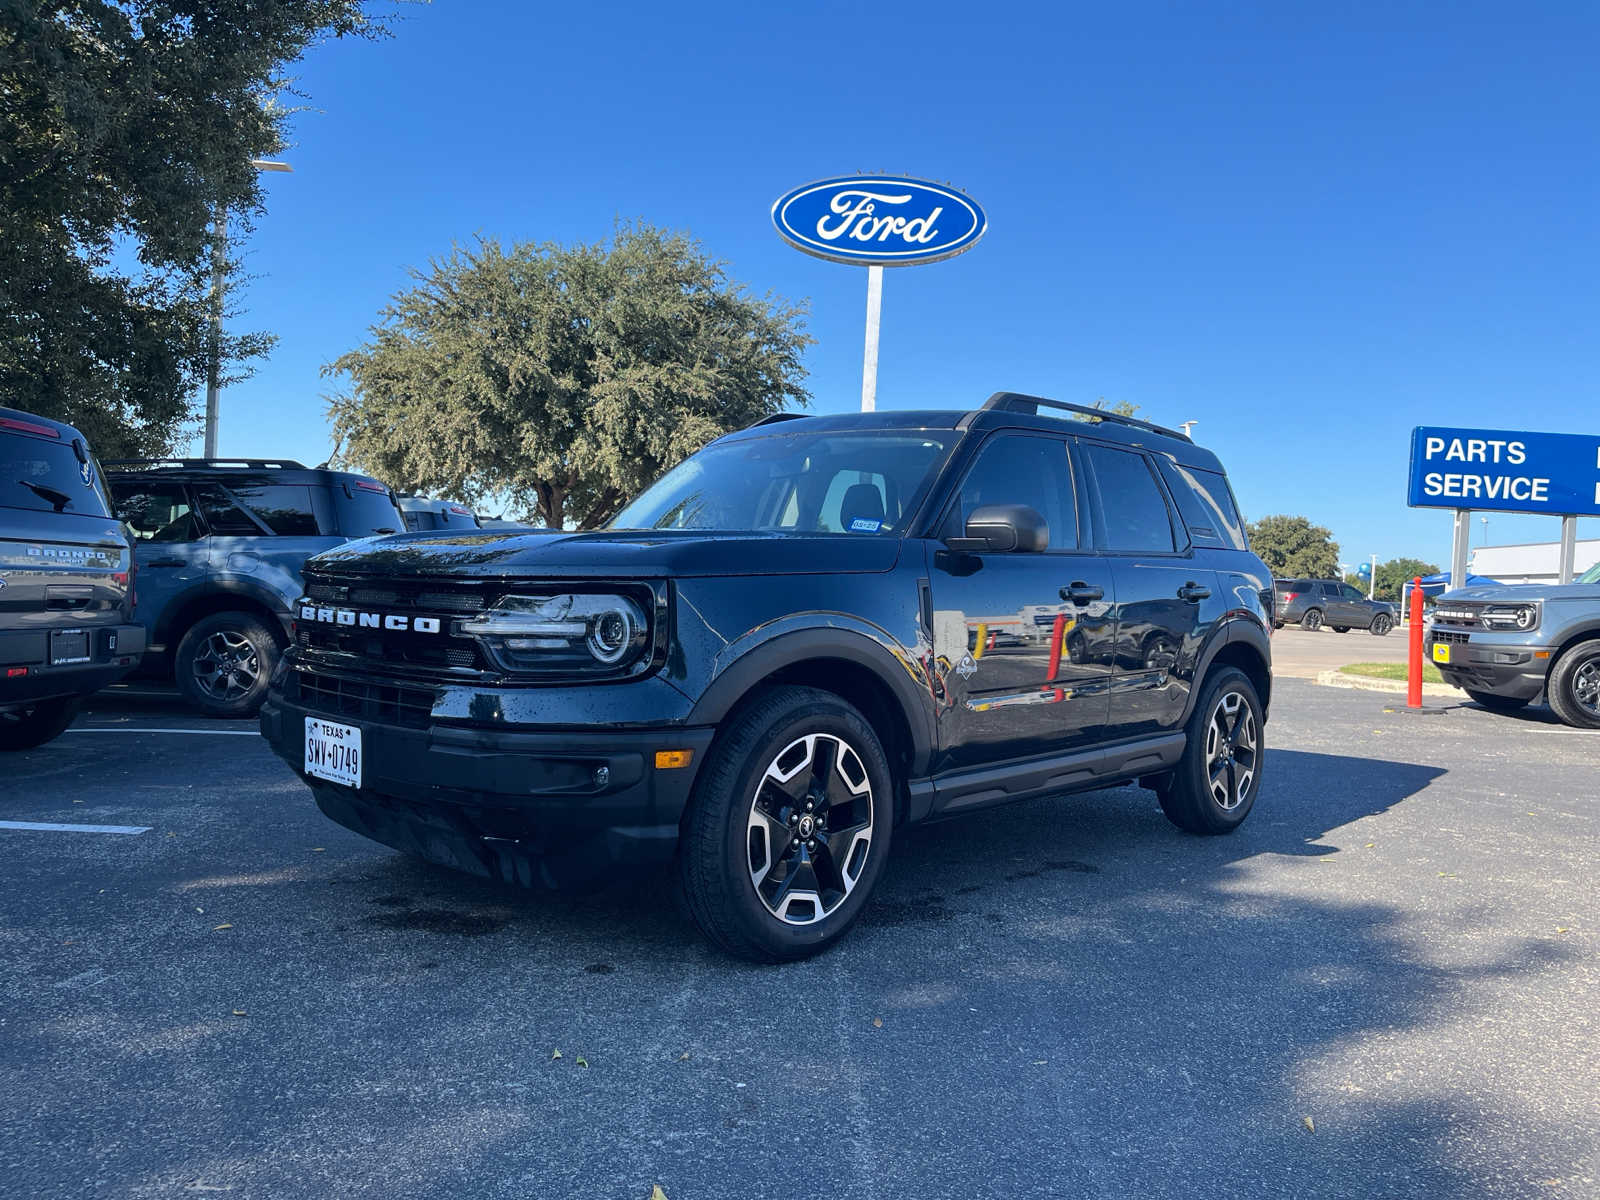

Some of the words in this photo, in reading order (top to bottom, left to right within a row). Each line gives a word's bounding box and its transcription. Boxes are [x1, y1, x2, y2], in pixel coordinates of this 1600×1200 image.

[816, 190, 943, 243] Ford
[1425, 437, 1526, 465] PARTS
[1424, 472, 1550, 502] SERVICE
[301, 606, 441, 634] BRONCO
[322, 725, 344, 739] TEXAS
